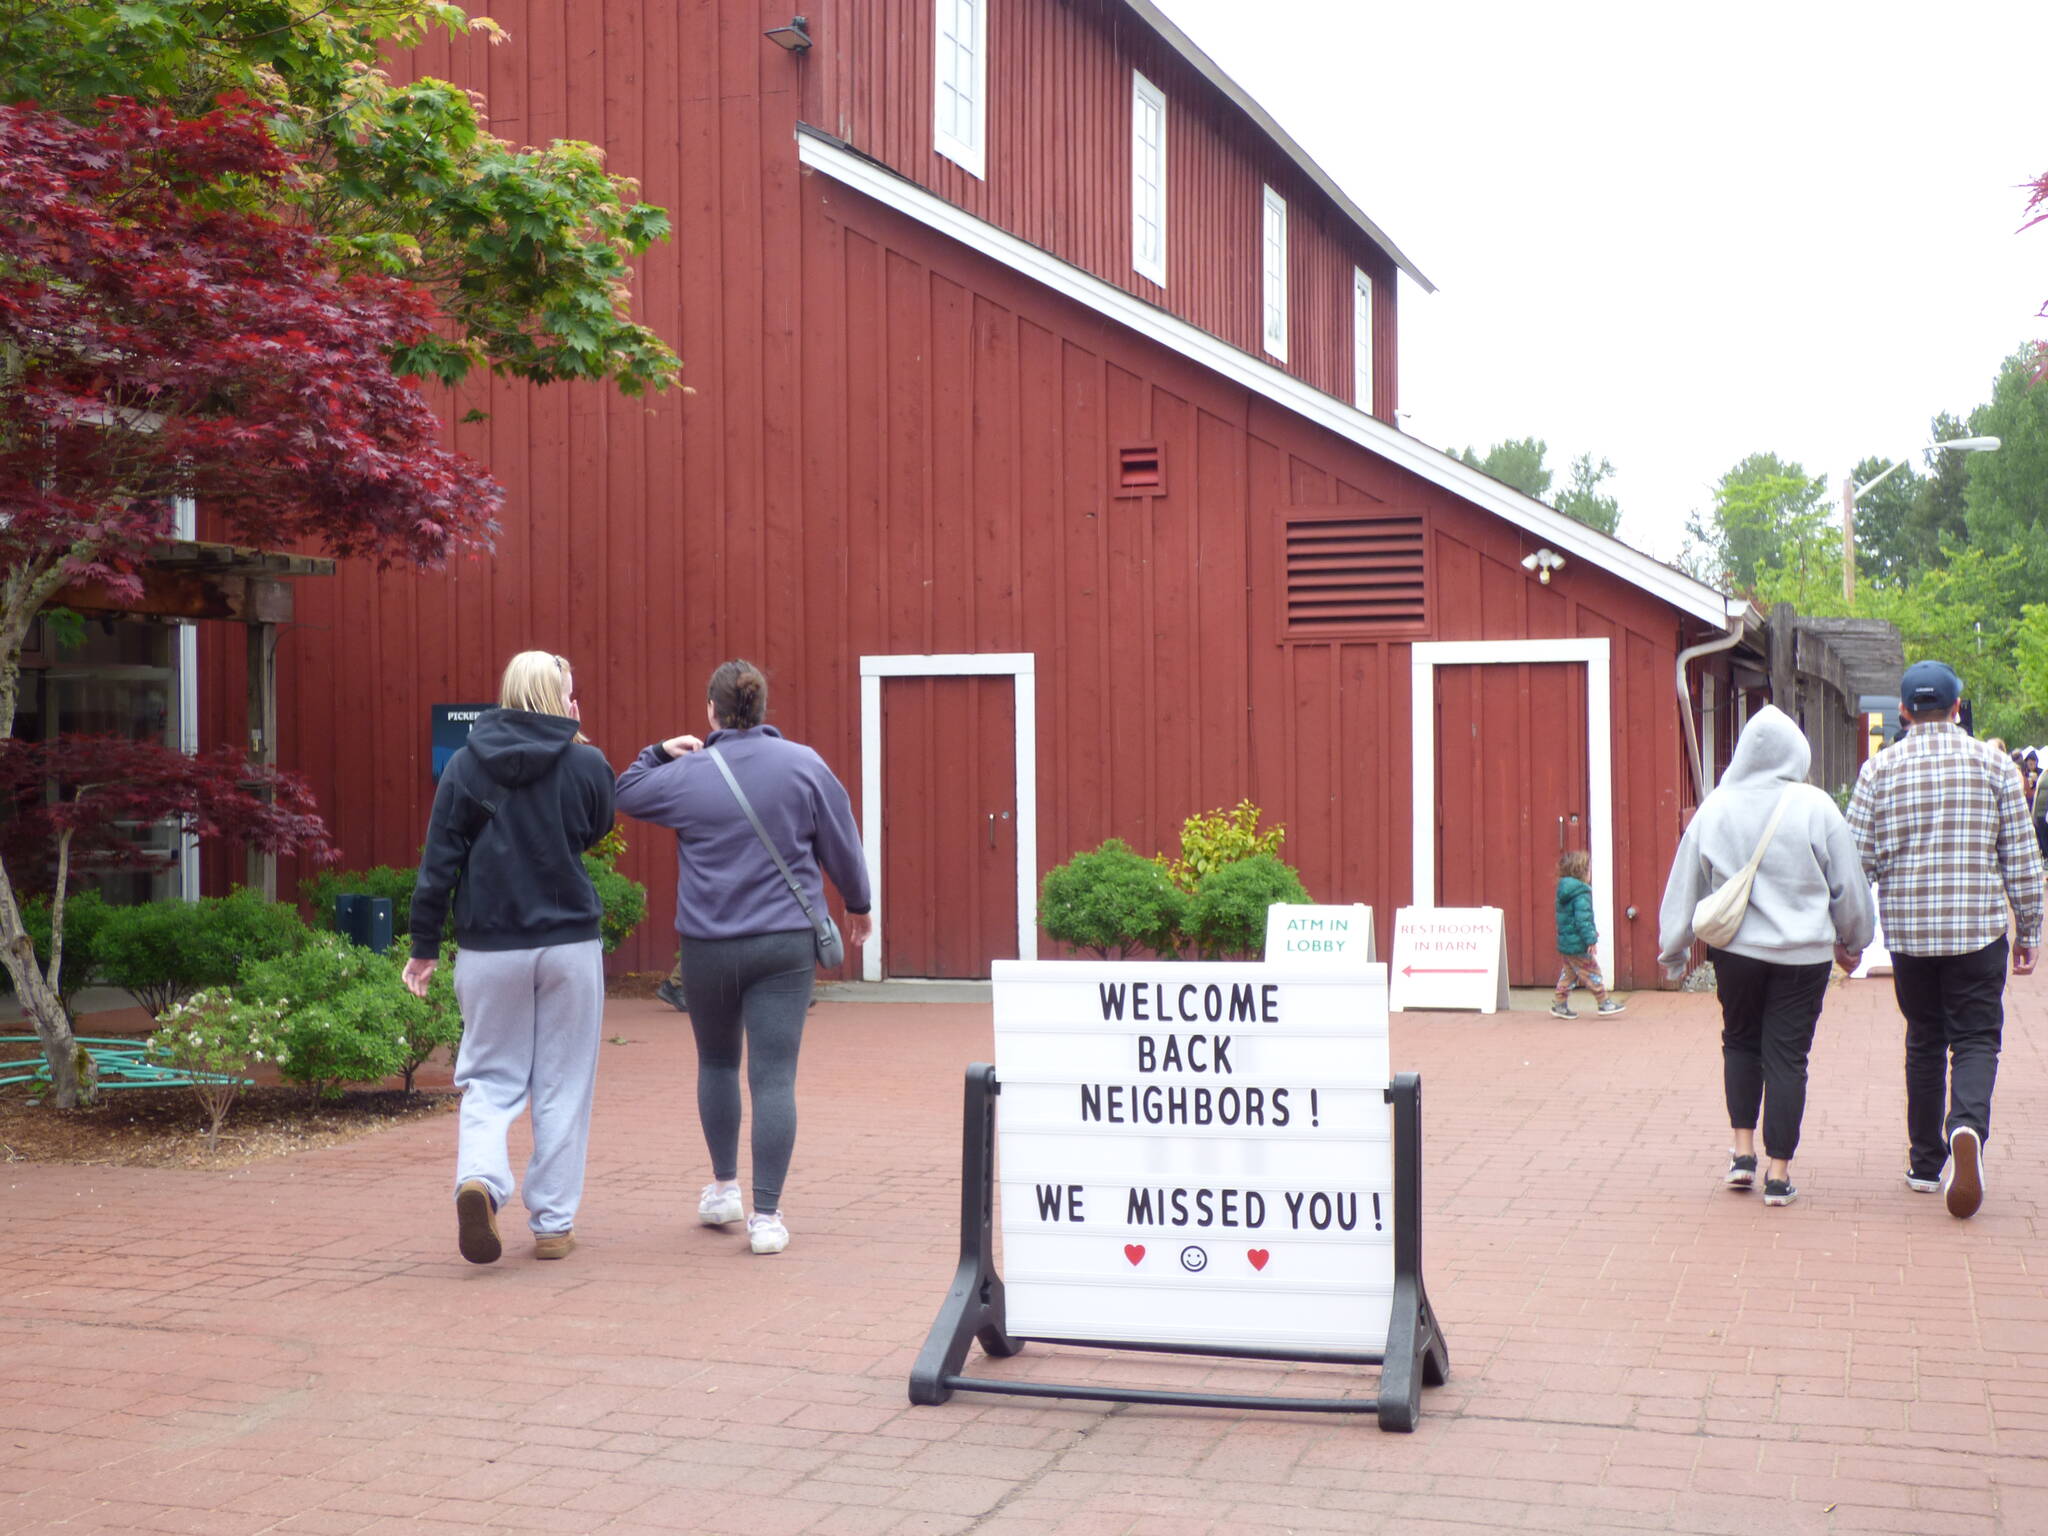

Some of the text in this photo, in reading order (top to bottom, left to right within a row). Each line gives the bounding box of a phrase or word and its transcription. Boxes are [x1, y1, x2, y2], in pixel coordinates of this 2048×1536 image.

[1287, 919, 1349, 931] ATM IN
[1401, 924, 1494, 935] RESTROOMS
[1286, 940, 1347, 953] LOBBY
[1414, 941, 1478, 952] IN BARN
[1099, 982, 1279, 1023] WELCOME
[1138, 1034, 1233, 1074] BACK
[1035, 1184, 1085, 1223] WE
[1126, 1187, 1266, 1229] MISSED
